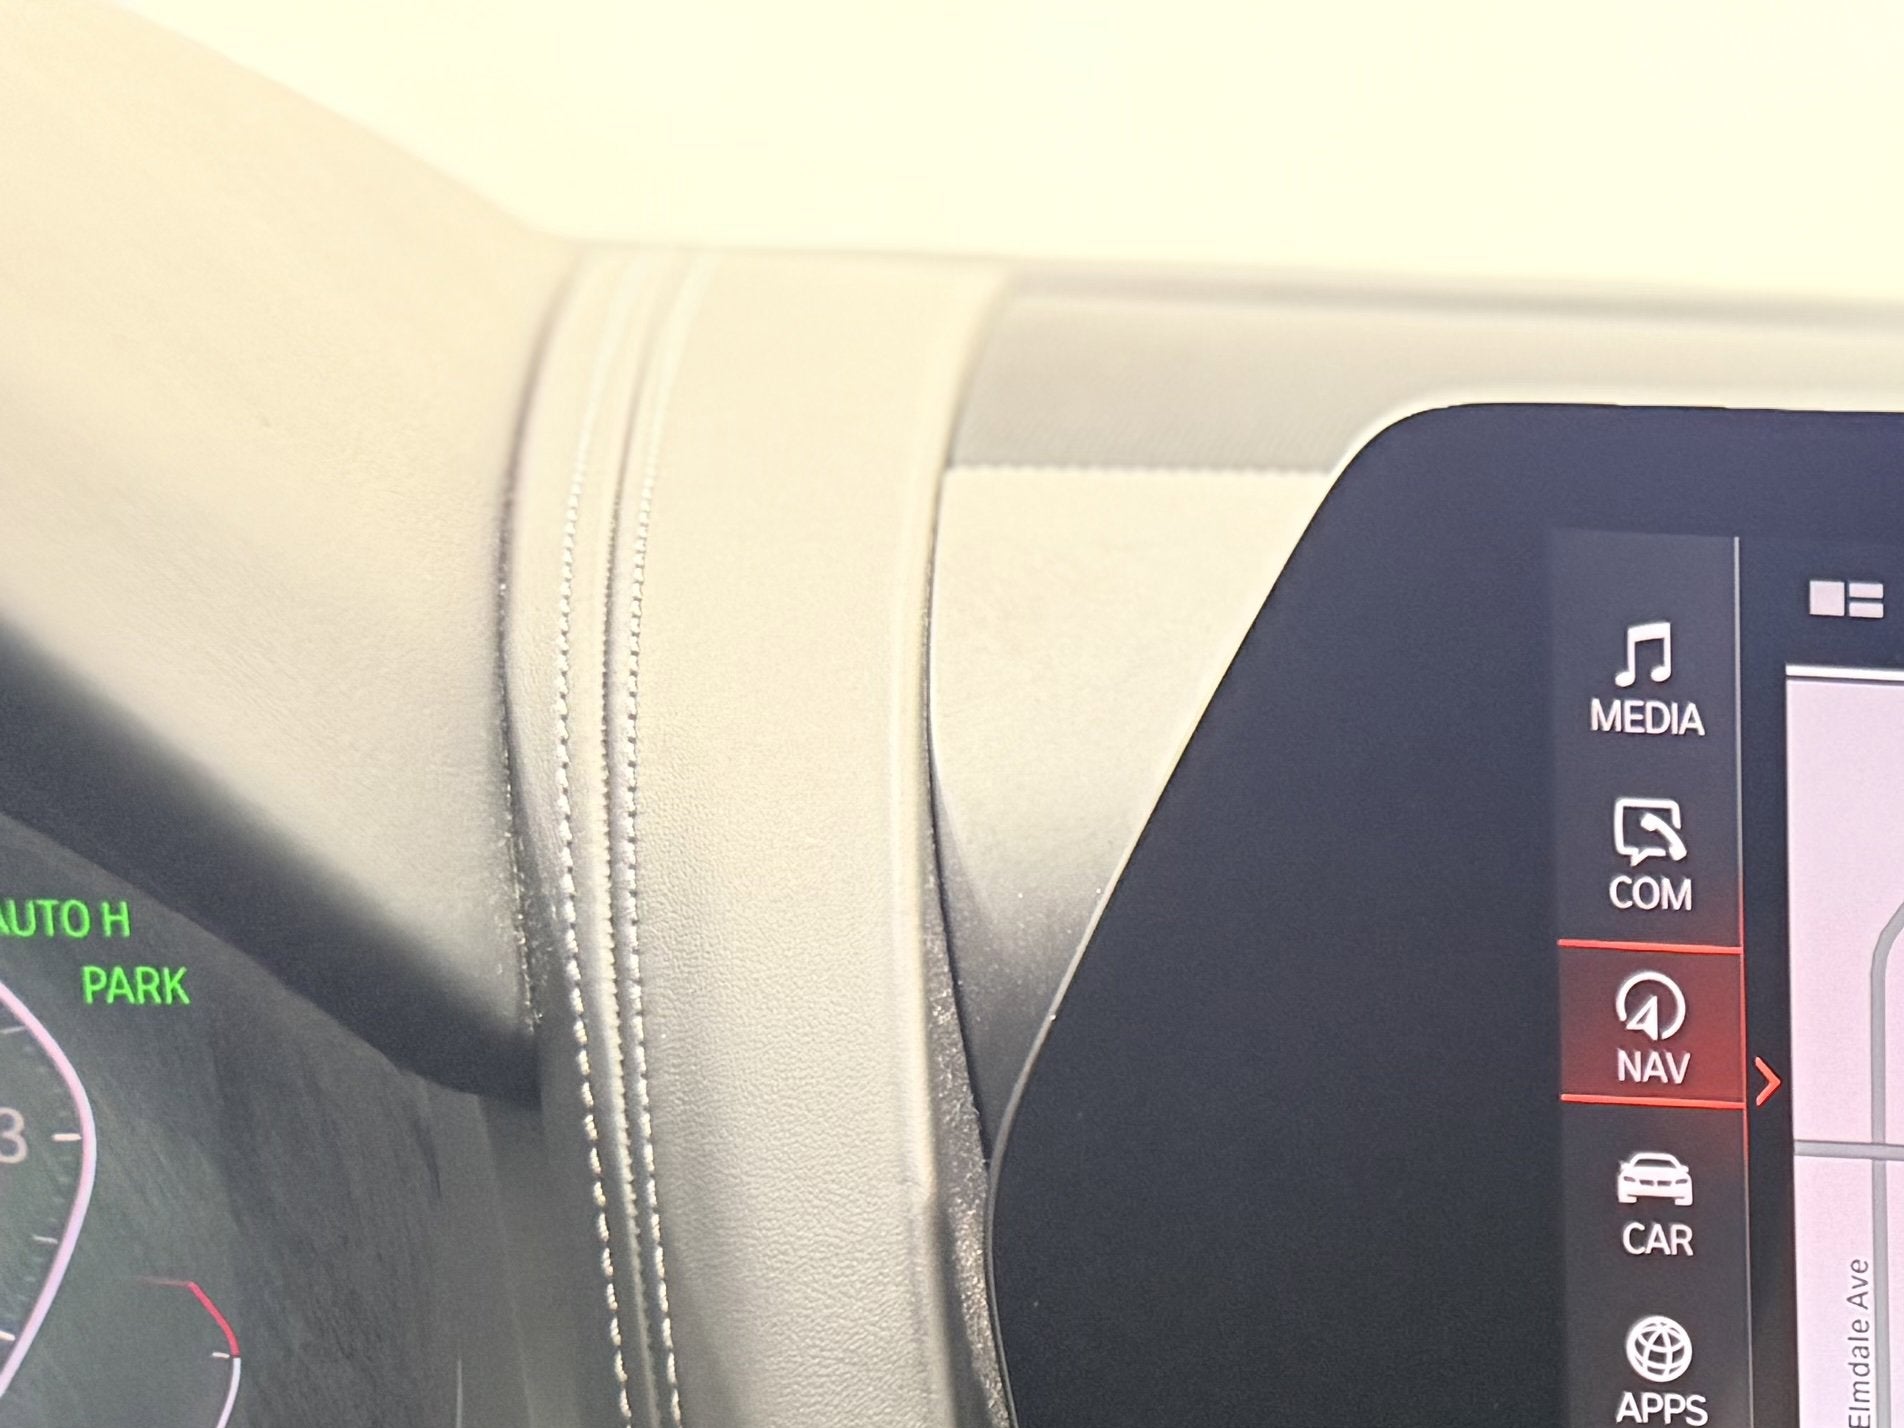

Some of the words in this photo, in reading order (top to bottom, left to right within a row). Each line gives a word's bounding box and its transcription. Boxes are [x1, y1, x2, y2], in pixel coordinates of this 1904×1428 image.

[1590, 698, 1705, 736] MEDIA
[1608, 875, 1693, 912] COM
[101, 900, 131, 938] H
[81, 965, 191, 1005] PARK
[1616, 1048, 1691, 1086] NAV
[0, 1106, 28, 1164] 3
[1622, 1222, 1694, 1257] CAR
[1846, 1257, 1870, 1310] Ave
[1615, 1391, 1709, 1427] APPS
